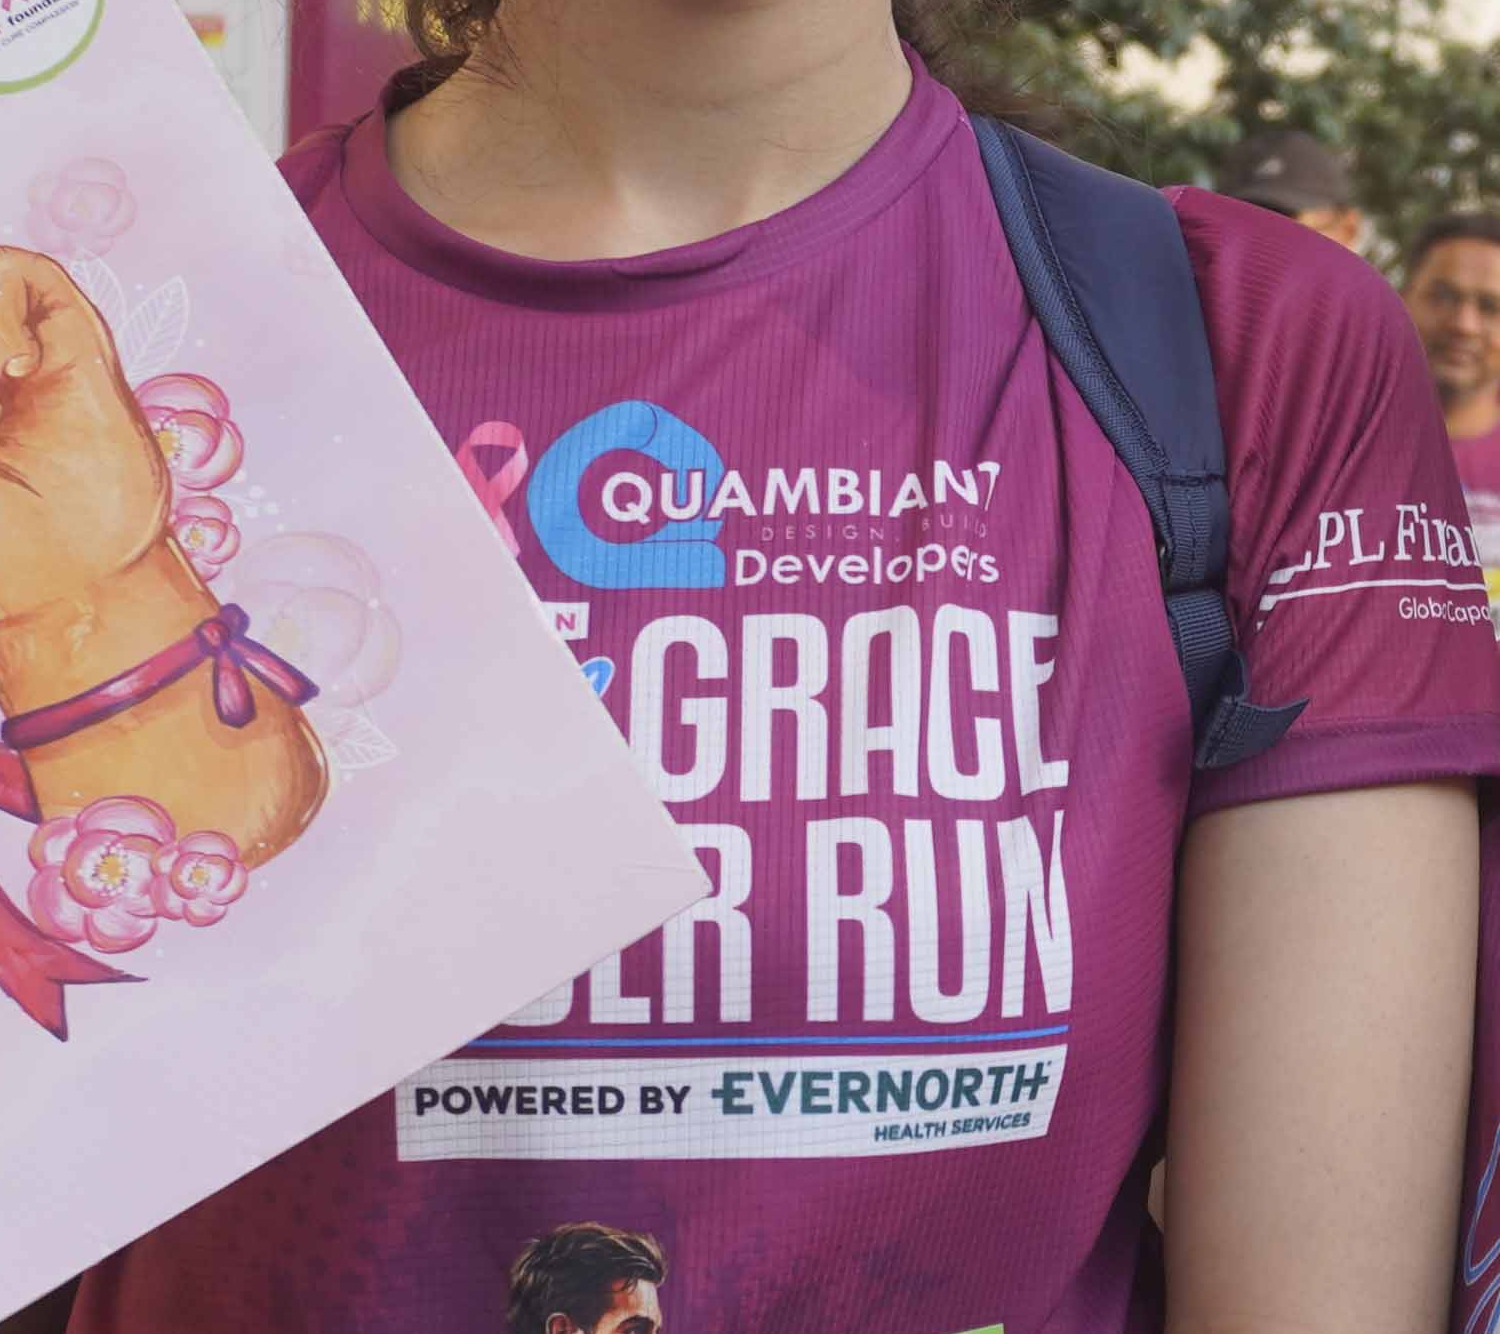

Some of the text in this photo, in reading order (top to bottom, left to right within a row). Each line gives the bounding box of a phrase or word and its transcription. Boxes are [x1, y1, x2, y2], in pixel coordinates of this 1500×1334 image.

[601, 459, 1001, 526] QUAMBIANT
[735, 542, 1000, 587] Developers
[627, 603, 1070, 804] GRACE
[805, 809, 1074, 1024] RUN
[414, 1062, 1049, 1117] POWERED BY EVERNORTH
[874, 1111, 1032, 1143] HEALTH SERVICES
